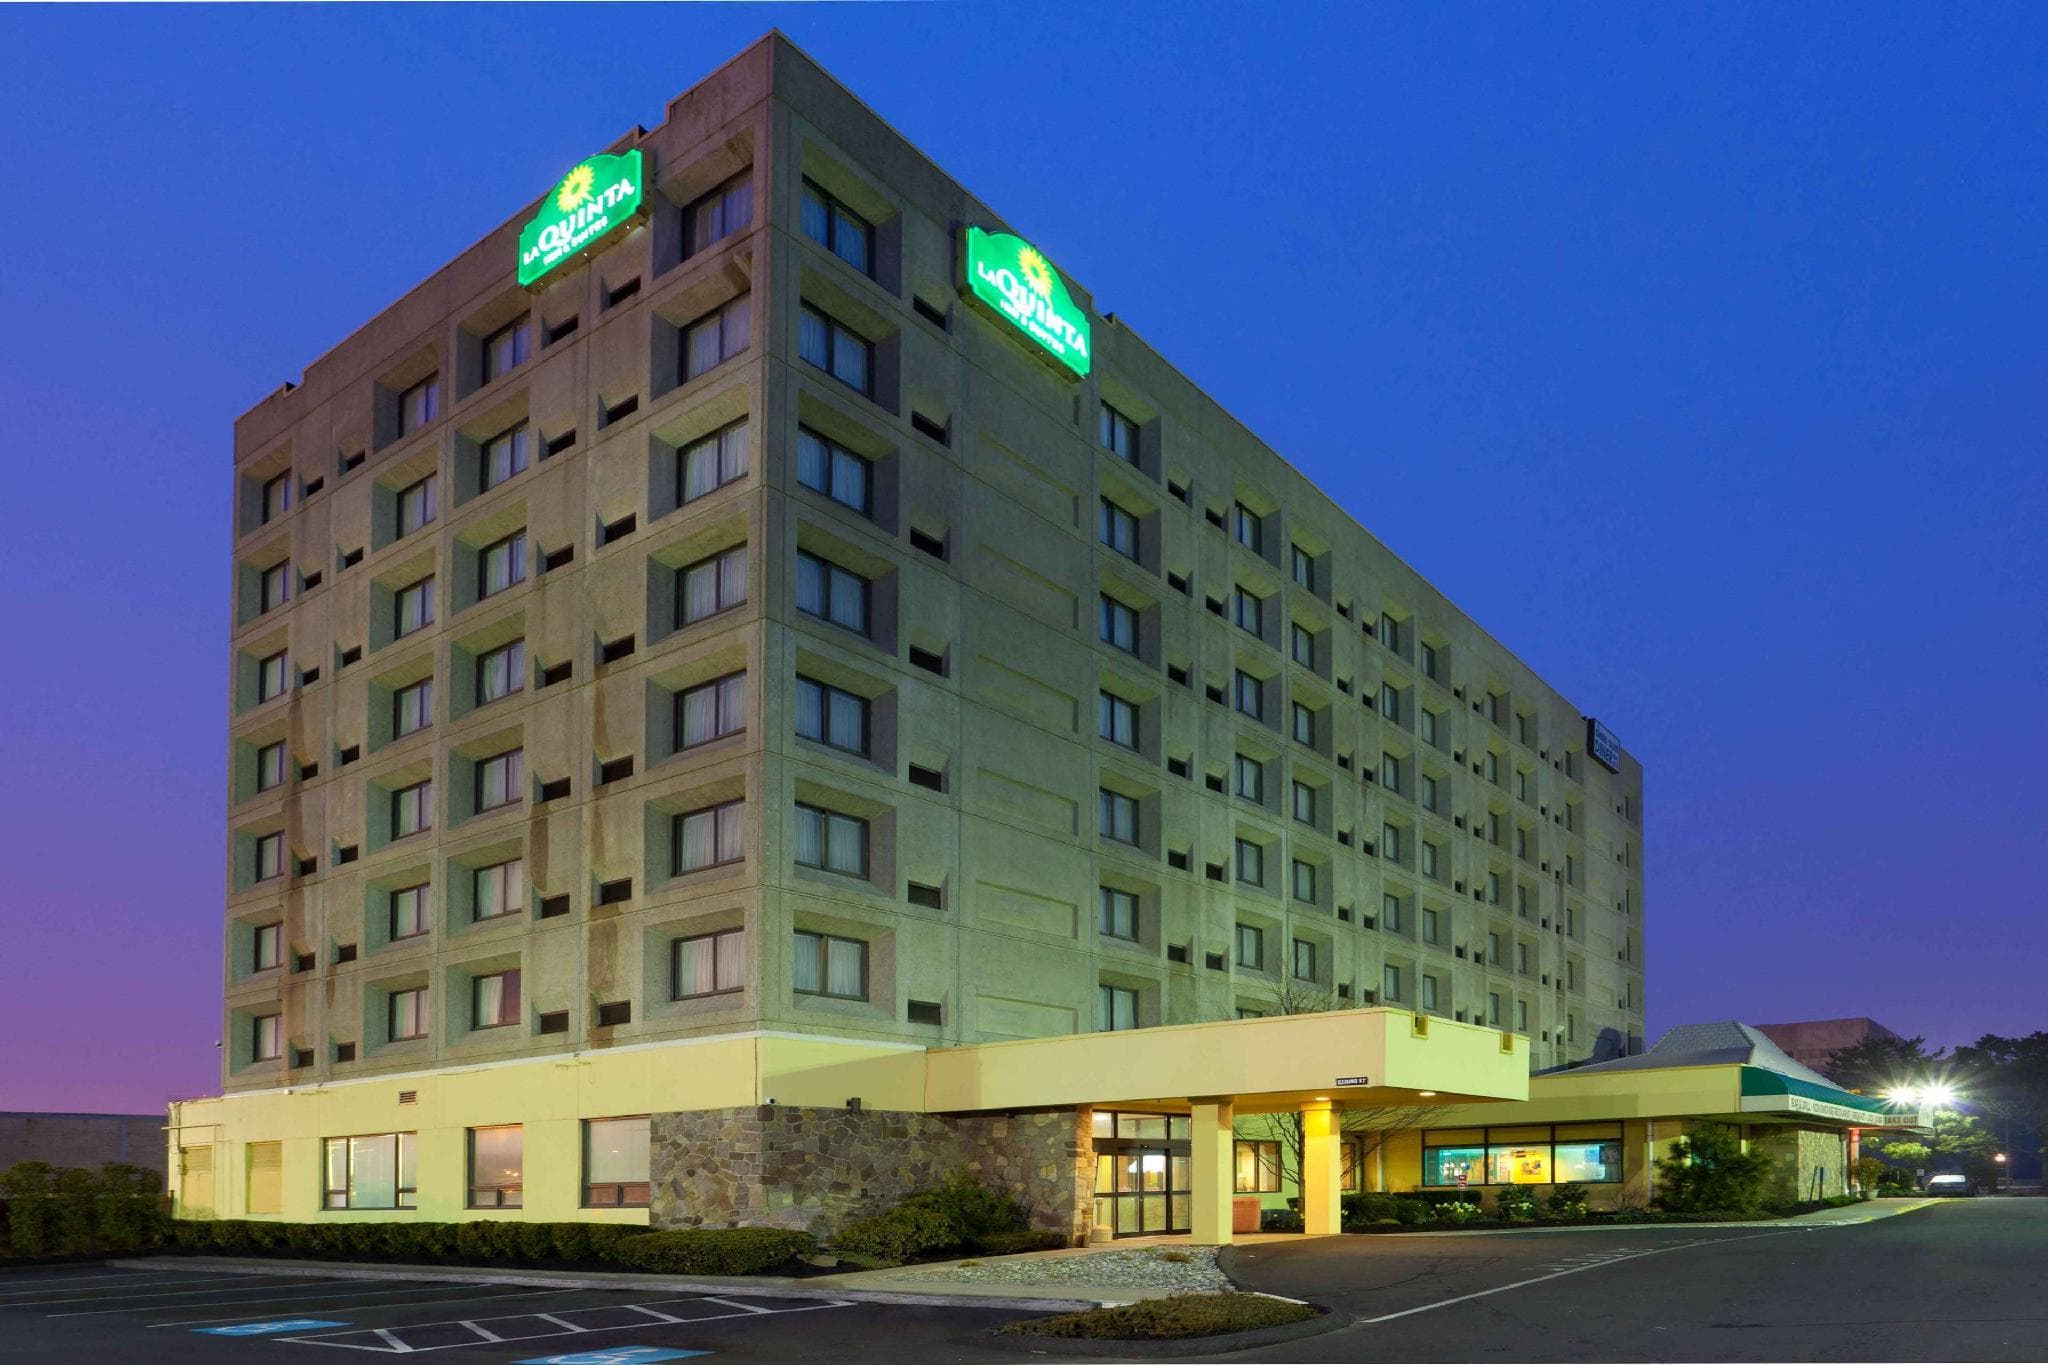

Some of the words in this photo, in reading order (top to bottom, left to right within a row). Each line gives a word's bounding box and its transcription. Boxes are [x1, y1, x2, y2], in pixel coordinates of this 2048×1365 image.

[523, 246, 540, 265] LA
[538, 178, 636, 252] QUINTA
[977, 261, 997, 288] LA
[995, 268, 1088, 358] QUINTA
[1884, 1116, 1900, 1124] TAKE
